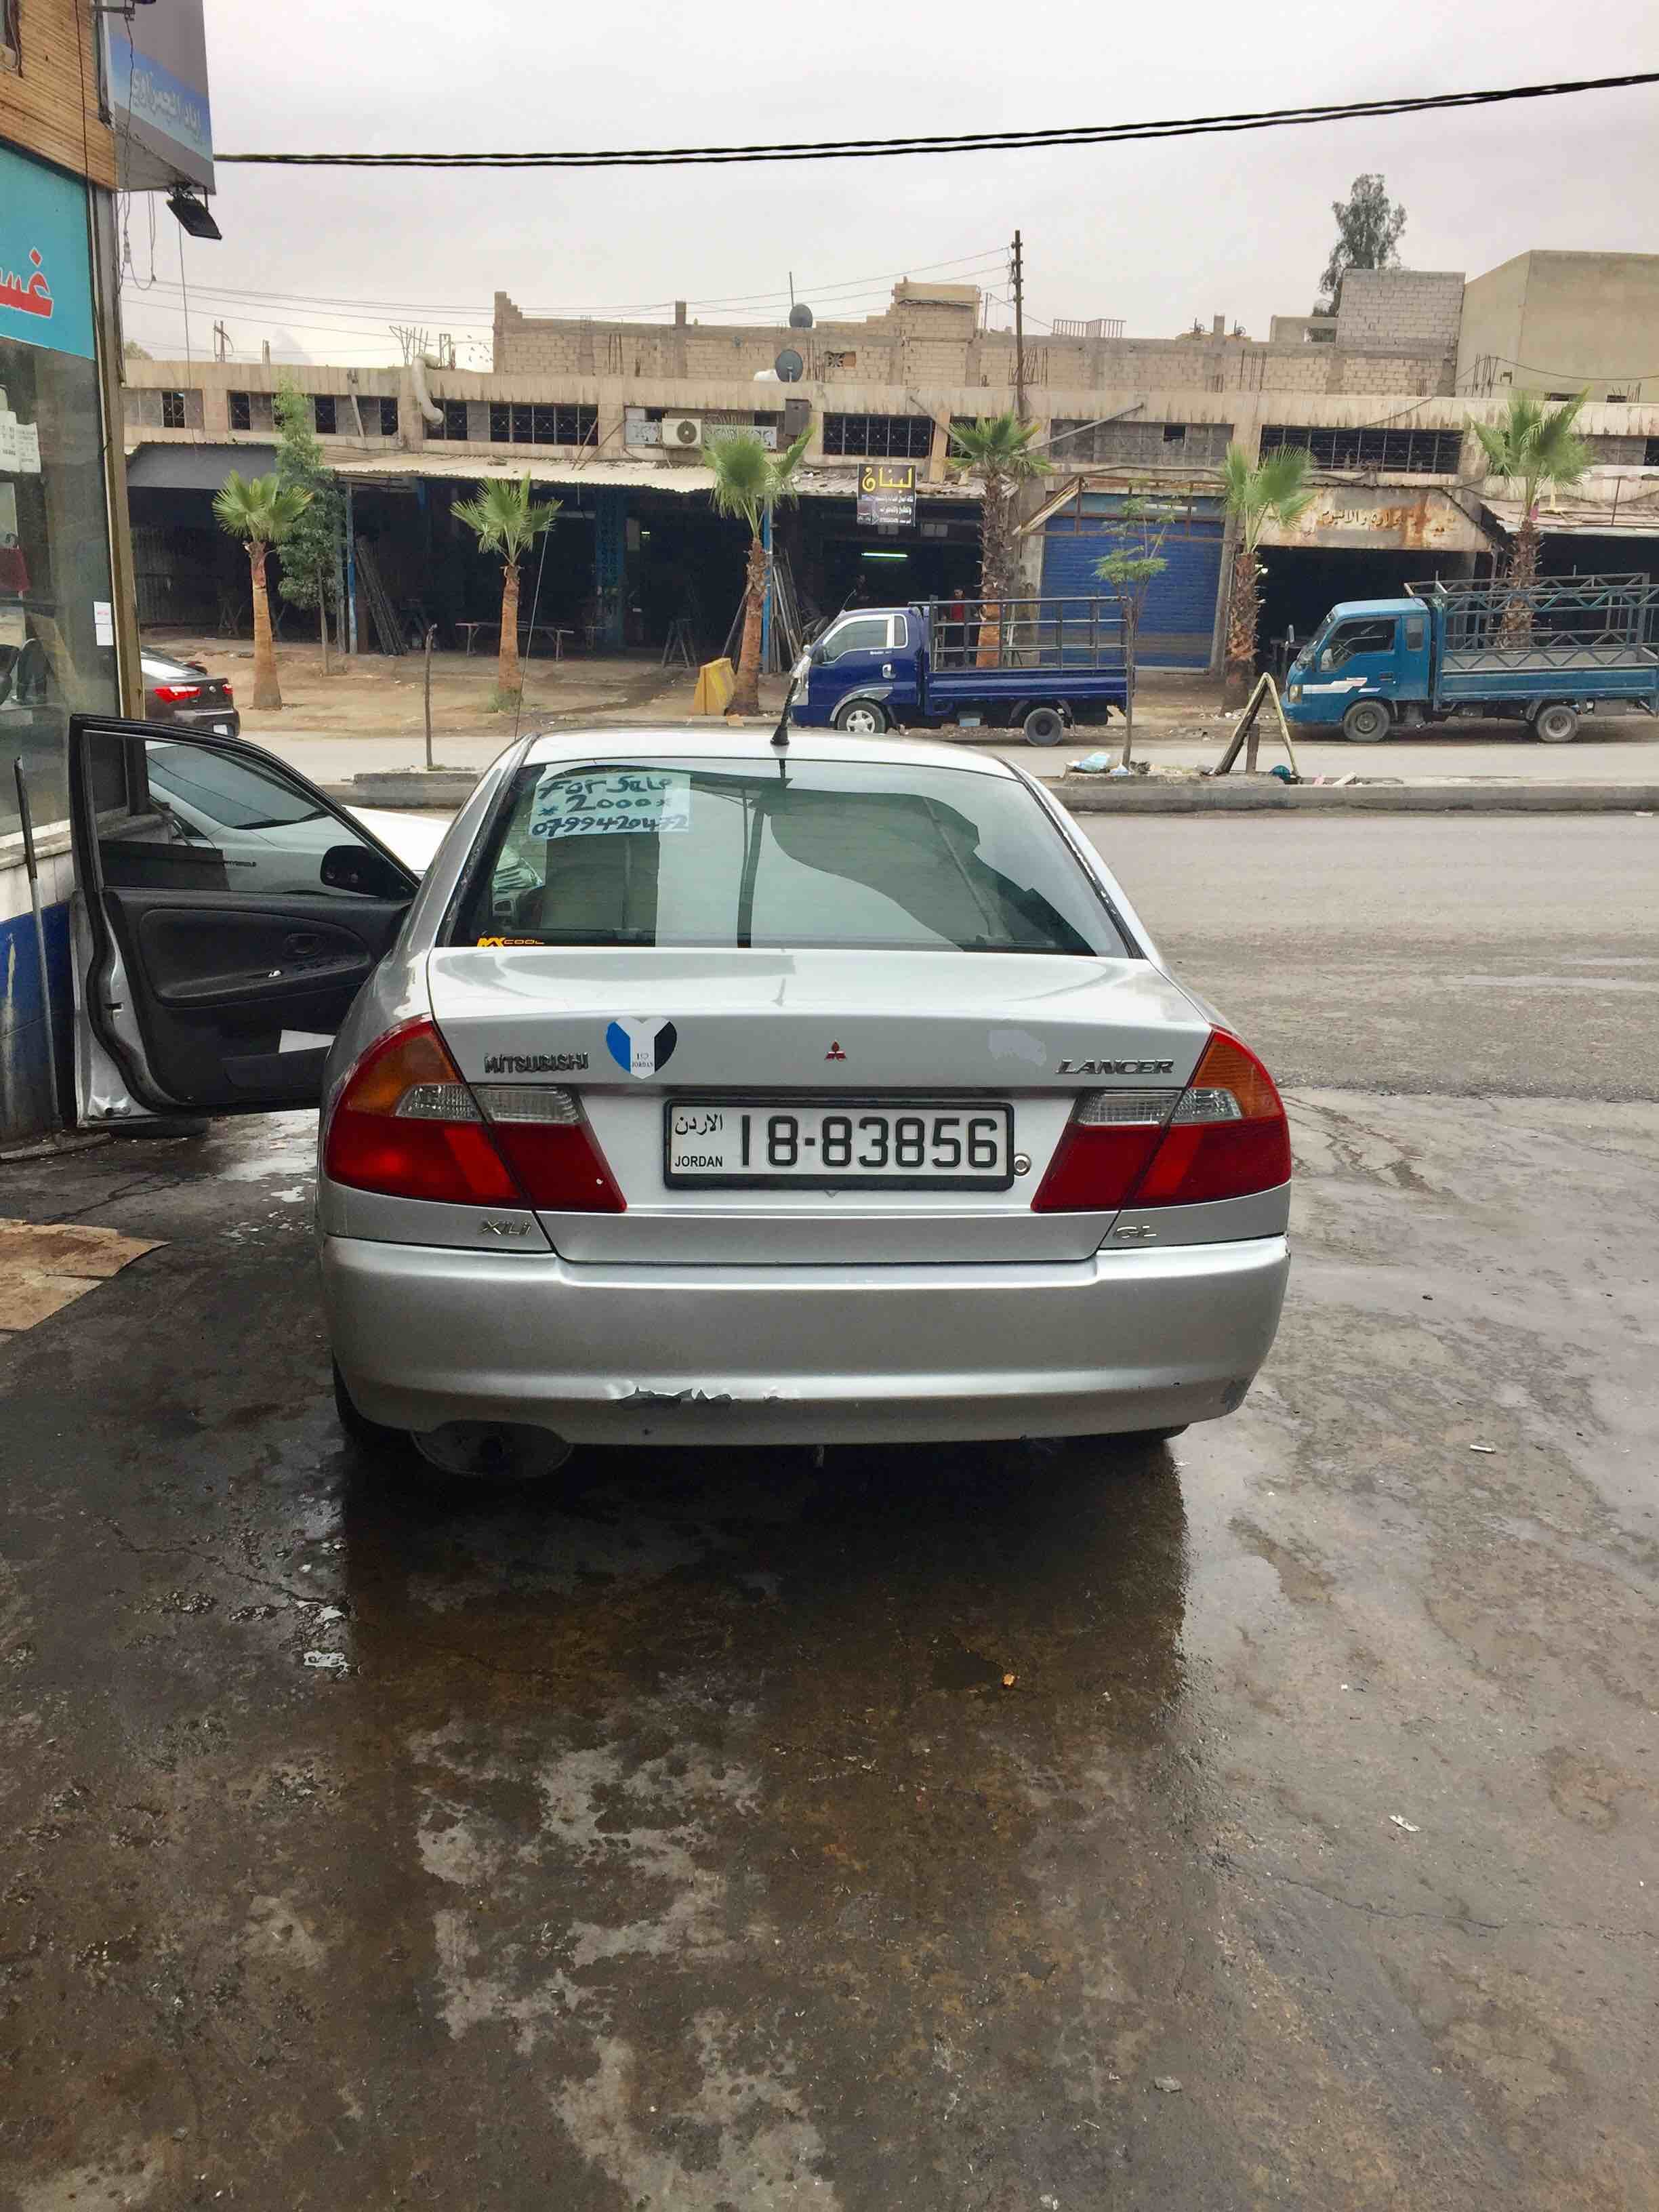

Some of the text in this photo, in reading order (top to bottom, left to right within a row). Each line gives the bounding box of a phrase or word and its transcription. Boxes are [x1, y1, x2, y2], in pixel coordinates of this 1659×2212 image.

[484, 1052, 589, 1073] MITSUBISHI
[1055, 1059, 1174, 1075] LANCER
[675, 1113, 723, 1135] الاردن
[741, 1114, 998, 1168] 18-83856
[675, 1155, 722, 1167] JORDAN
